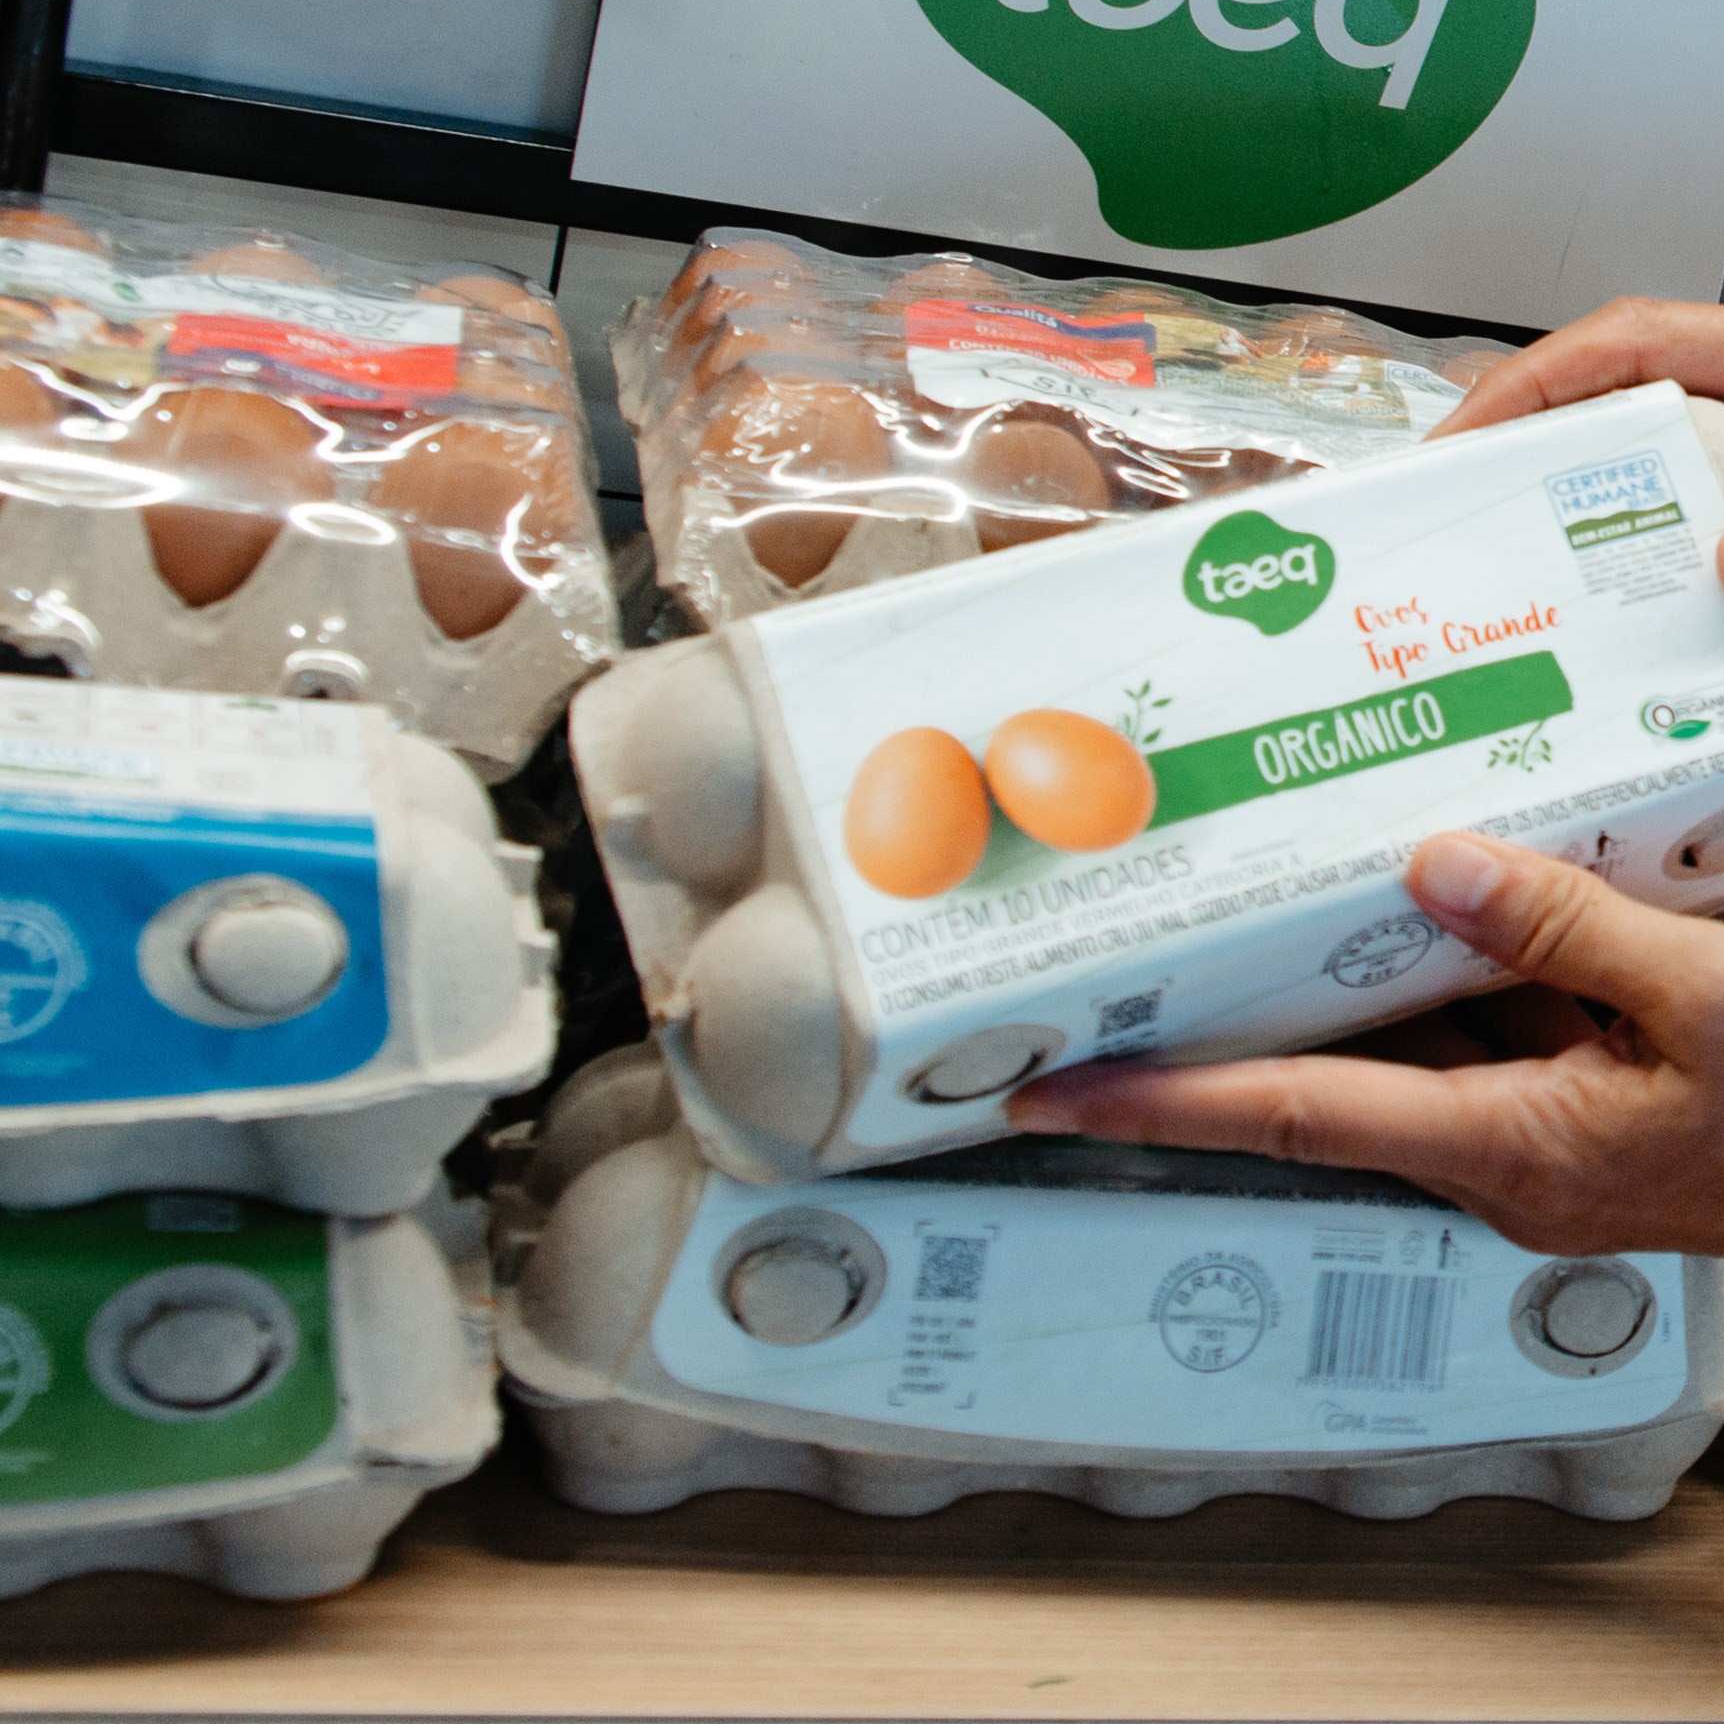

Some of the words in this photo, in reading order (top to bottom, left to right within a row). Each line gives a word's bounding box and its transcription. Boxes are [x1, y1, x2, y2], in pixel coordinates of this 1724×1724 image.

[1552, 458, 1658, 497] CERTIFIED
[1561, 477, 1658, 514] HUMANE
[1197, 543, 1319, 604] taeq
[1354, 596, 1428, 634] Ovos
[1361, 639, 1430, 679] Tipo
[1442, 601, 1561, 655] Grande
[1253, 691, 1446, 785] ORGÂNICO
[859, 897, 992, 965] CONTÉM
[1001, 890, 1036, 926] 10
[1040, 843, 1196, 914] UNIDADES
[1174, 1270, 1256, 1311] BRASIL
